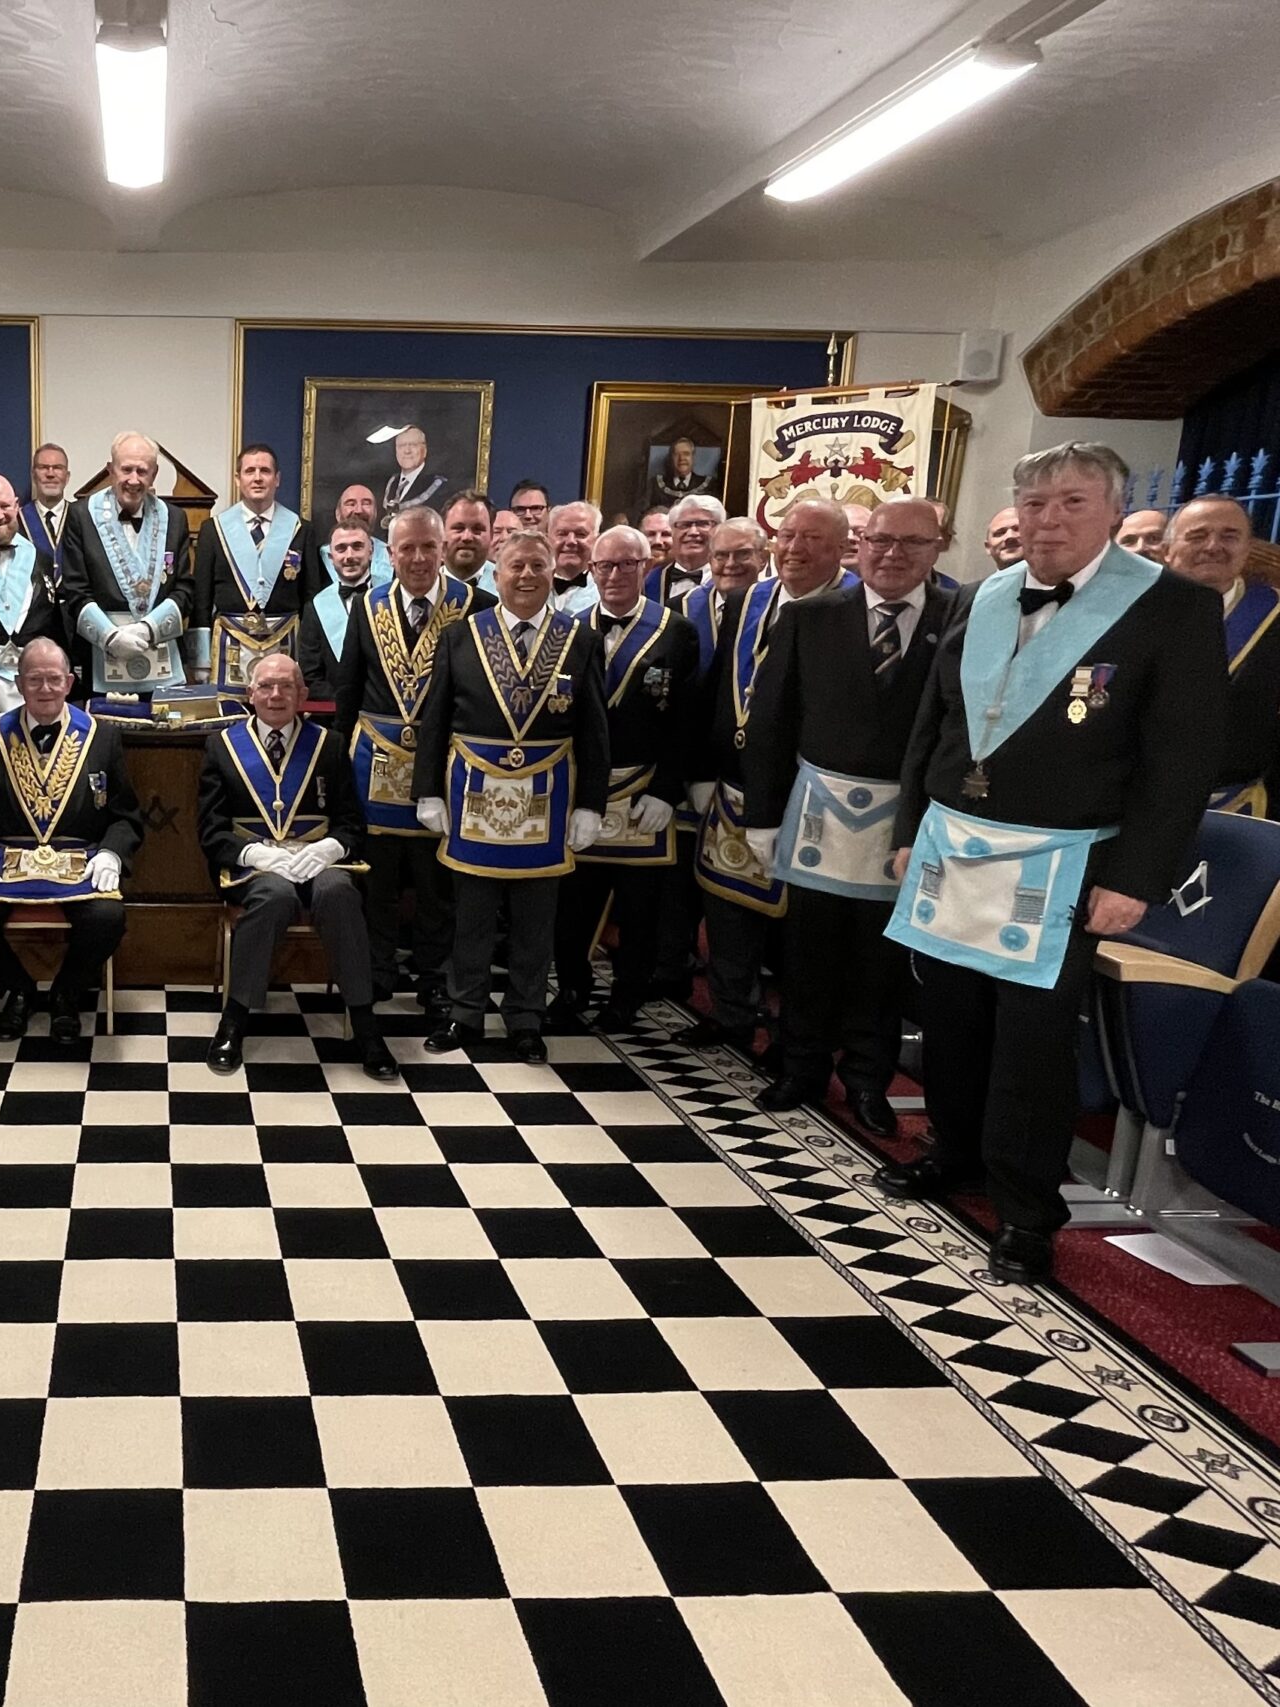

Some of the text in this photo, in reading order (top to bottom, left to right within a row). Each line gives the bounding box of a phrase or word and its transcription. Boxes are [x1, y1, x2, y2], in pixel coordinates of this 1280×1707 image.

[782, 415, 897, 440] MERCURY LODGE
[1254, 1090, 1271, 1106] The
